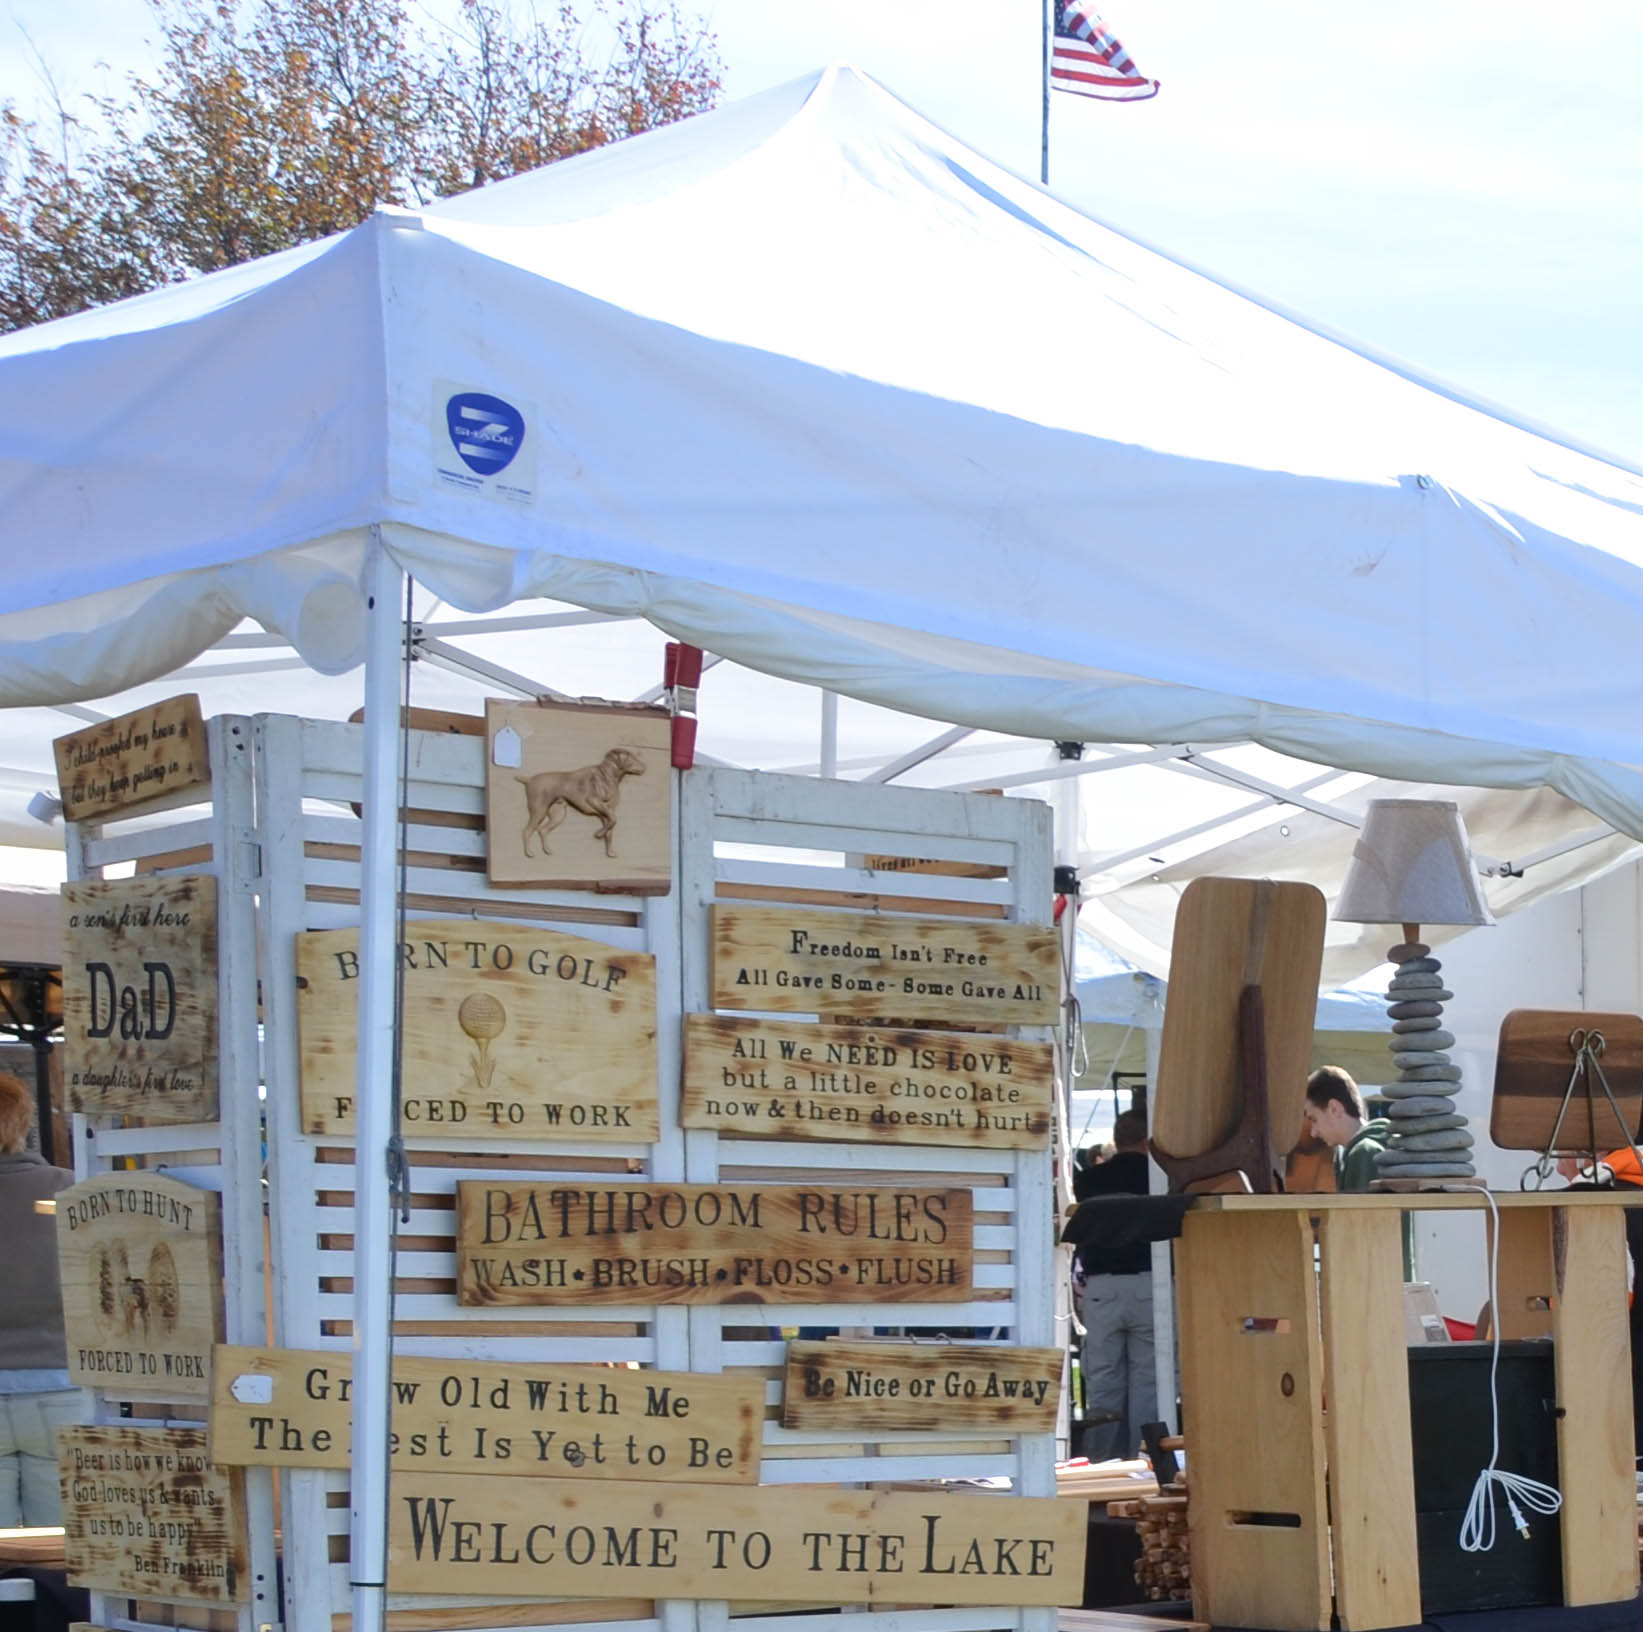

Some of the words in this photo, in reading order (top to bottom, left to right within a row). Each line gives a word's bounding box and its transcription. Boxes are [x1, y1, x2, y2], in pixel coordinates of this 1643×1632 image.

[70, 916, 80, 928] a
[790, 930, 881, 960] Freedom
[891, 944, 933, 963] Isn't
[943, 948, 988, 967] Free
[333, 941, 449, 981] BRN
[464, 943, 513, 971] TO
[527, 948, 627, 994] GOLF
[736, 968, 768, 986] All
[776, 971, 823, 989] Gave
[903, 977, 954, 997] Some
[962, 981, 1006, 999] Gave
[1012, 985, 1041, 1001] All
[732, 1038, 767, 1059] All
[779, 1040, 813, 1062] We
[826, 1043, 897, 1068] NEED
[911, 1049, 935, 1070] IS
[945, 1051, 1013, 1075] LOVE
[722, 1067, 769, 1089] but
[784, 1076, 797, 1090] a
[810, 1070, 877, 1096] little
[889, 1077, 1021, 1103] chocolate
[334, 1096, 467, 1122] FCED
[486, 1102, 525, 1125] TO
[544, 1103, 631, 1127] WORK
[705, 1099, 760, 1118] now
[768, 1099, 786, 1118] &
[795, 1101, 860, 1123] then
[871, 1104, 965, 1128] doesn't
[975, 1109, 1033, 1132] hurt
[67, 1190, 112, 1231] BORN
[115, 1189, 137, 1213] TO
[143, 1190, 193, 1232] HUNT
[481, 1188, 764, 1245] BATHROOM
[796, 1191, 949, 1247] RULES
[470, 1257, 568, 1287] WASH
[591, 1256, 710, 1288] BRUSH
[733, 1256, 834, 1286] FLOSS
[854, 1256, 957, 1285] FLUSH
[78, 1349, 133, 1374] FORCED
[138, 1352, 157, 1375] TO
[163, 1354, 205, 1378] WORK
[305, 1368, 421, 1406] Grw
[440, 1377, 511, 1411] Old
[525, 1380, 620, 1416] With
[644, 1386, 691, 1419] Me
[803, 1367, 835, 1398] Be
[845, 1369, 900, 1398] Nice
[909, 1376, 936, 1398] or
[943, 1372, 975, 1398] Go
[983, 1375, 1050, 1405] Away
[250, 1417, 333, 1453] The
[474, 1427, 513, 1460] Is
[532, 1430, 607, 1465] Yet
[627, 1436, 667, 1467] to
[688, 1437, 734, 1470] Be
[109, 1453, 121, 1471] is
[125, 1449, 151, 1471] how
[154, 1455, 173, 1472] we
[175, 1450, 213, 1473] know
[72, 1479, 97, 1502] God
[102, 1480, 136, 1503] loves
[139, 1490, 155, 1505] us
[89, 1517, 107, 1536] us
[110, 1516, 124, 1536] to
[126, 1514, 144, 1537] be
[402, 1496, 679, 1568] WELCOME
[706, 1529, 772, 1570] TO
[802, 1532, 905, 1574] THE
[918, 1515, 1055, 1577] LAKE
[134, 1555, 158, 1573] Ben
[163, 1557, 225, 1578] Franklin
